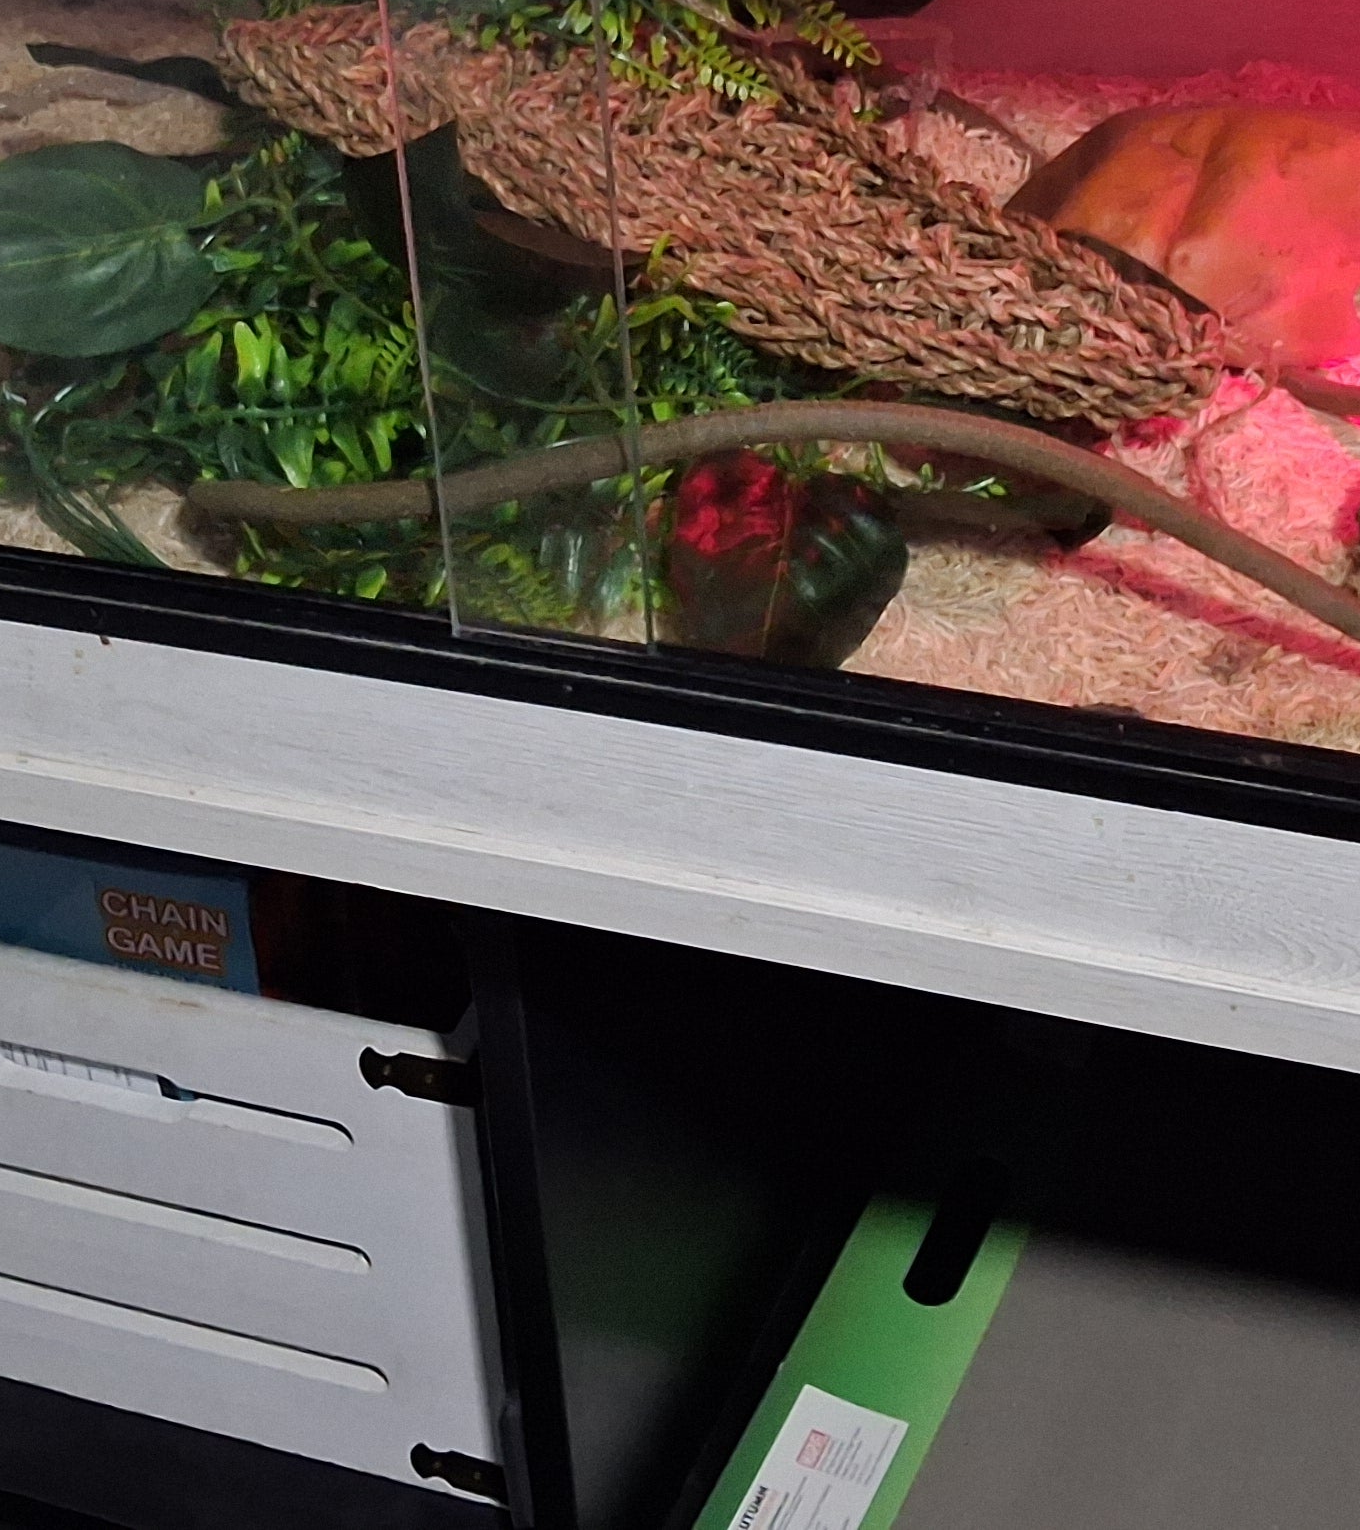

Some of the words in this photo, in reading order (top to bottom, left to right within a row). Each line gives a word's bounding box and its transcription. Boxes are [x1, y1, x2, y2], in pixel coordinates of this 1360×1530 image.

[101, 890, 228, 938] CHAIN
[107, 926, 221, 970] GAME
[737, 1484, 769, 1530] UTUMN
